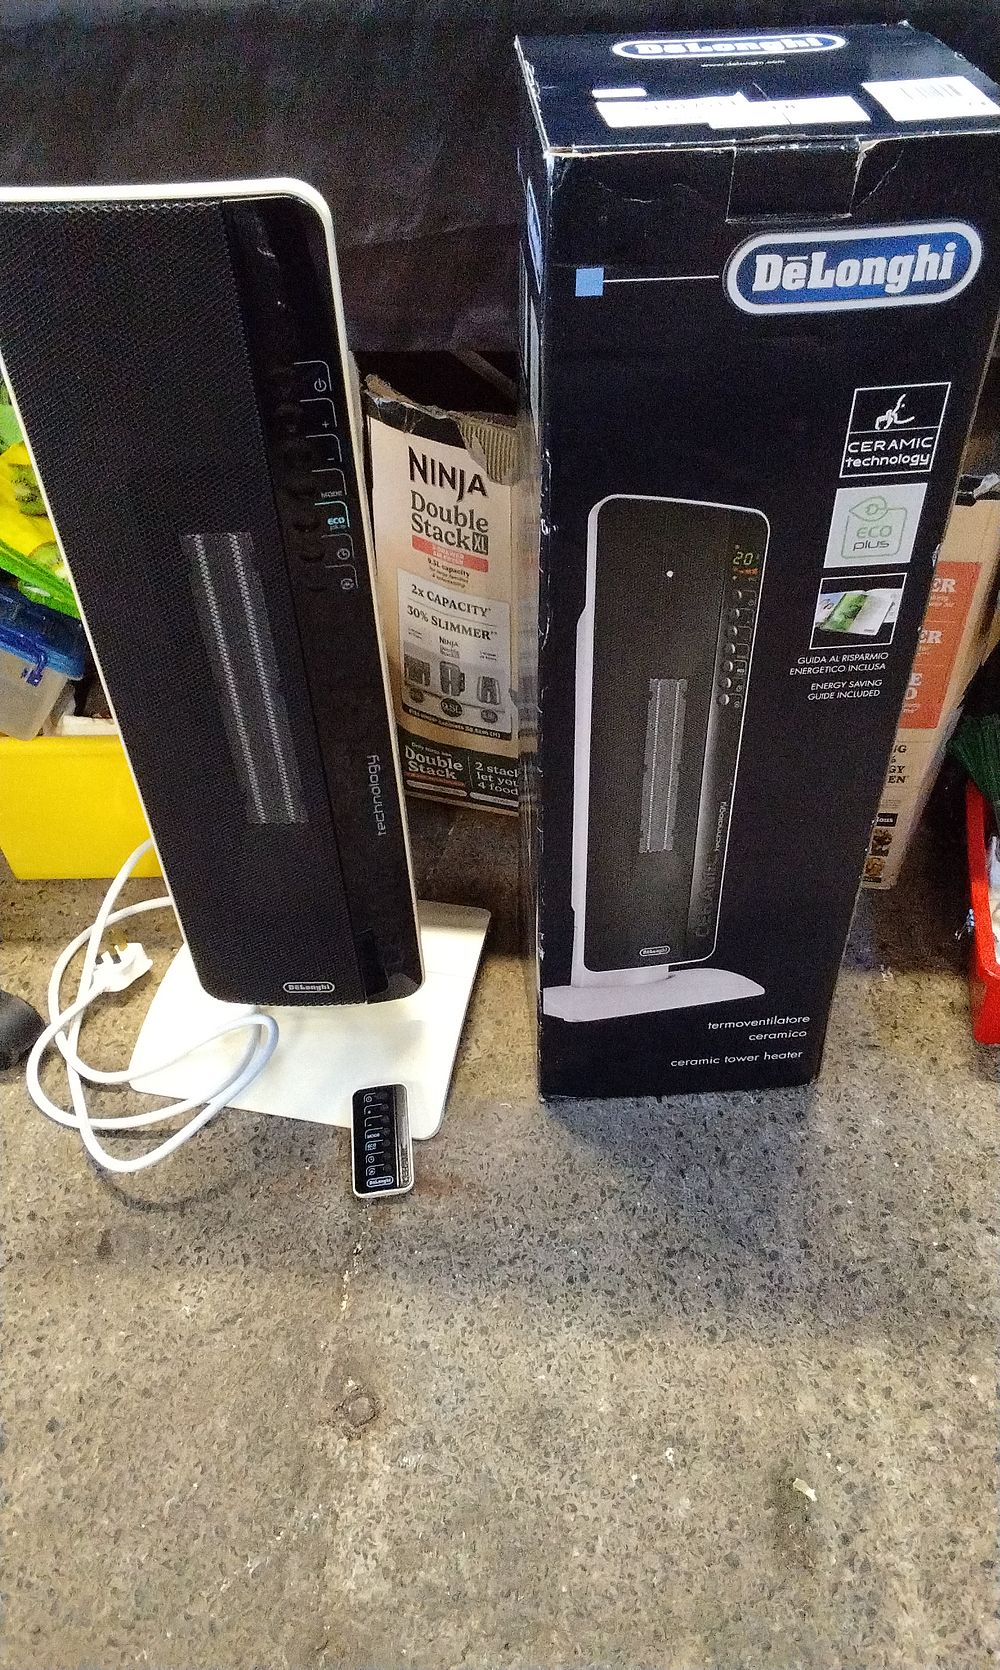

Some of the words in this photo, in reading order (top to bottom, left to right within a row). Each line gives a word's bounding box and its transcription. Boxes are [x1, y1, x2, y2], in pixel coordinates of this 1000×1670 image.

[847, 437, 934, 453] CERAMIC
[845, 453, 930, 468] technology
[408, 446, 489, 502] NINJA
[411, 490, 489, 533] Double
[411, 512, 470, 551] Stack
[853, 539, 889, 551] plus
[411, 583, 425, 598] 2x
[407, 605, 429, 623] 30%
[797, 656, 827, 665] GUIDA
[829, 655, 840, 663] AL
[841, 652, 889, 662] RISPARMIO
[789, 665, 846, 675] ENERGETICO
[848, 663, 886, 672] INCLUSA
[810, 681, 847, 691] ENERGY
[848, 680, 882, 688] SAVING
[807, 692, 835, 700] GUIDE
[836, 689, 880, 699] INCLUDED
[405, 745, 464, 771] Double
[408, 760, 457, 780] Stack
[475, 762, 483, 771] 2
[477, 772, 493, 782] let
[367, 754, 387, 836] technology
[490, 783, 519, 795] food
[708, 1015, 810, 1030] termoventilatore
[748, 1030, 807, 1041] ceramico
[670, 1056, 720, 1067] ceramic
[724, 1053, 760, 1063] tower
[763, 1051, 803, 1061] heater
